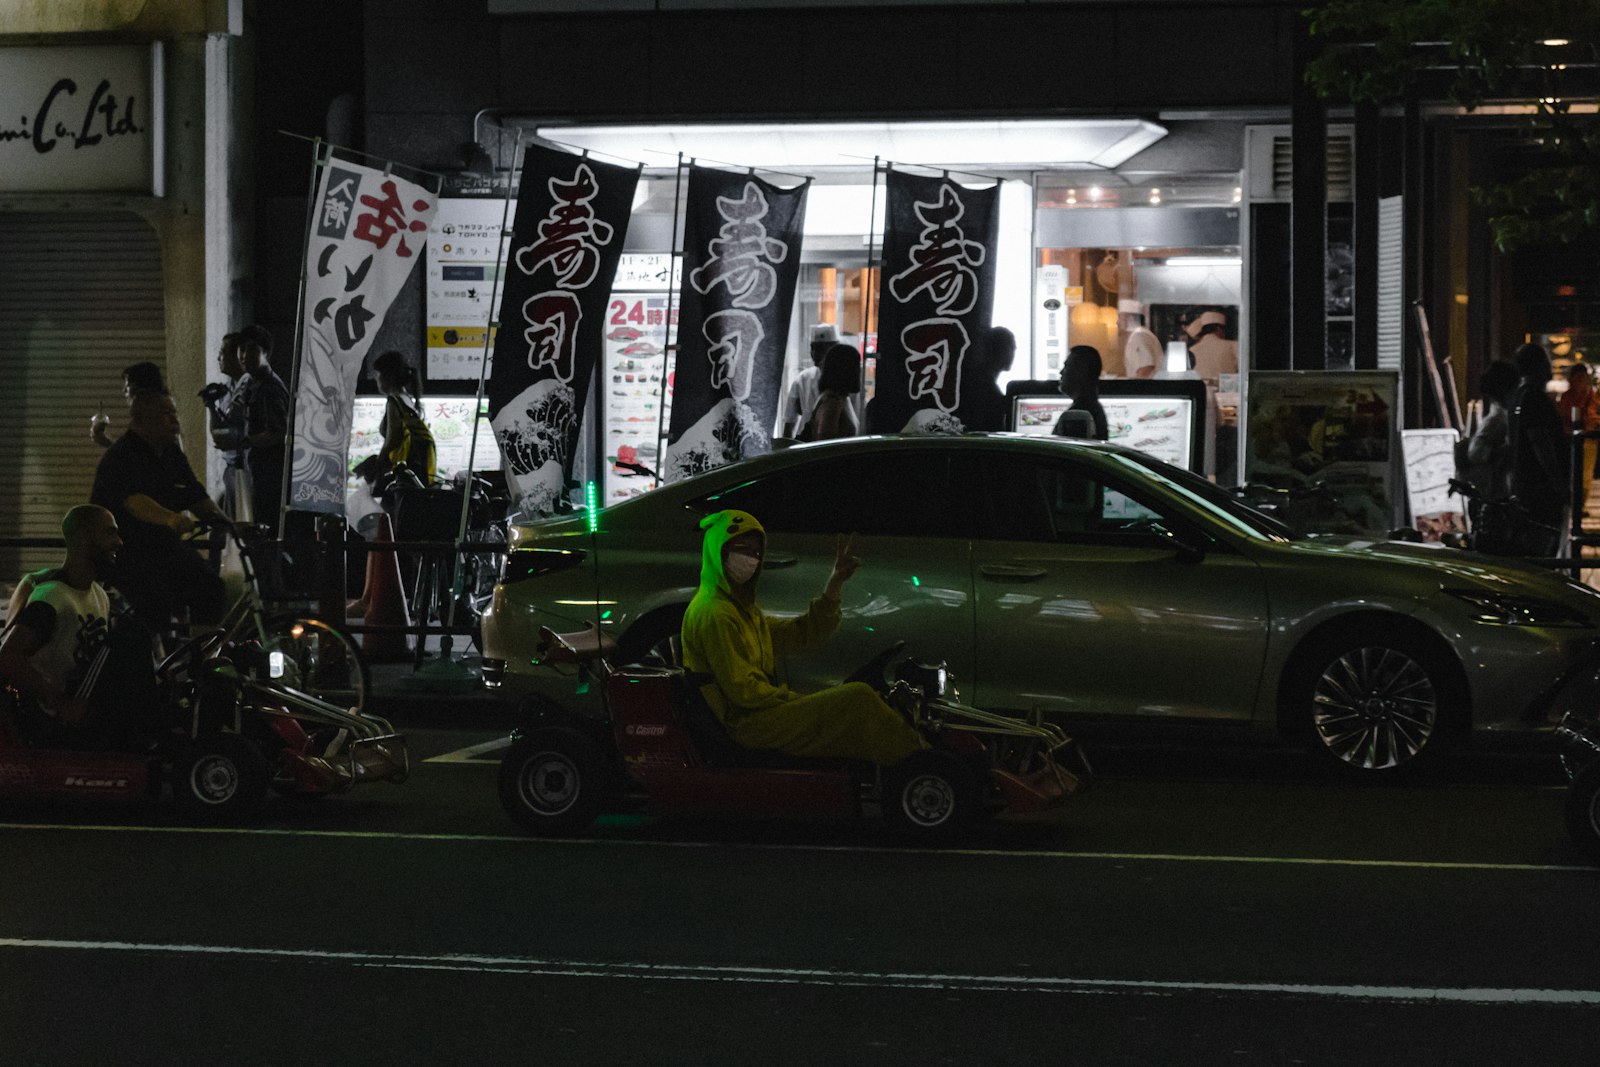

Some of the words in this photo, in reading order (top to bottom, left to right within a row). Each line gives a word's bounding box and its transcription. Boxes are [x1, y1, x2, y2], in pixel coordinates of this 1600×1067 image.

[75, 79, 144, 149] Ltd.
[515, 163, 614, 384] 寿司
[690, 181, 788, 402] 寿司
[889, 184, 986, 413] 寿司
